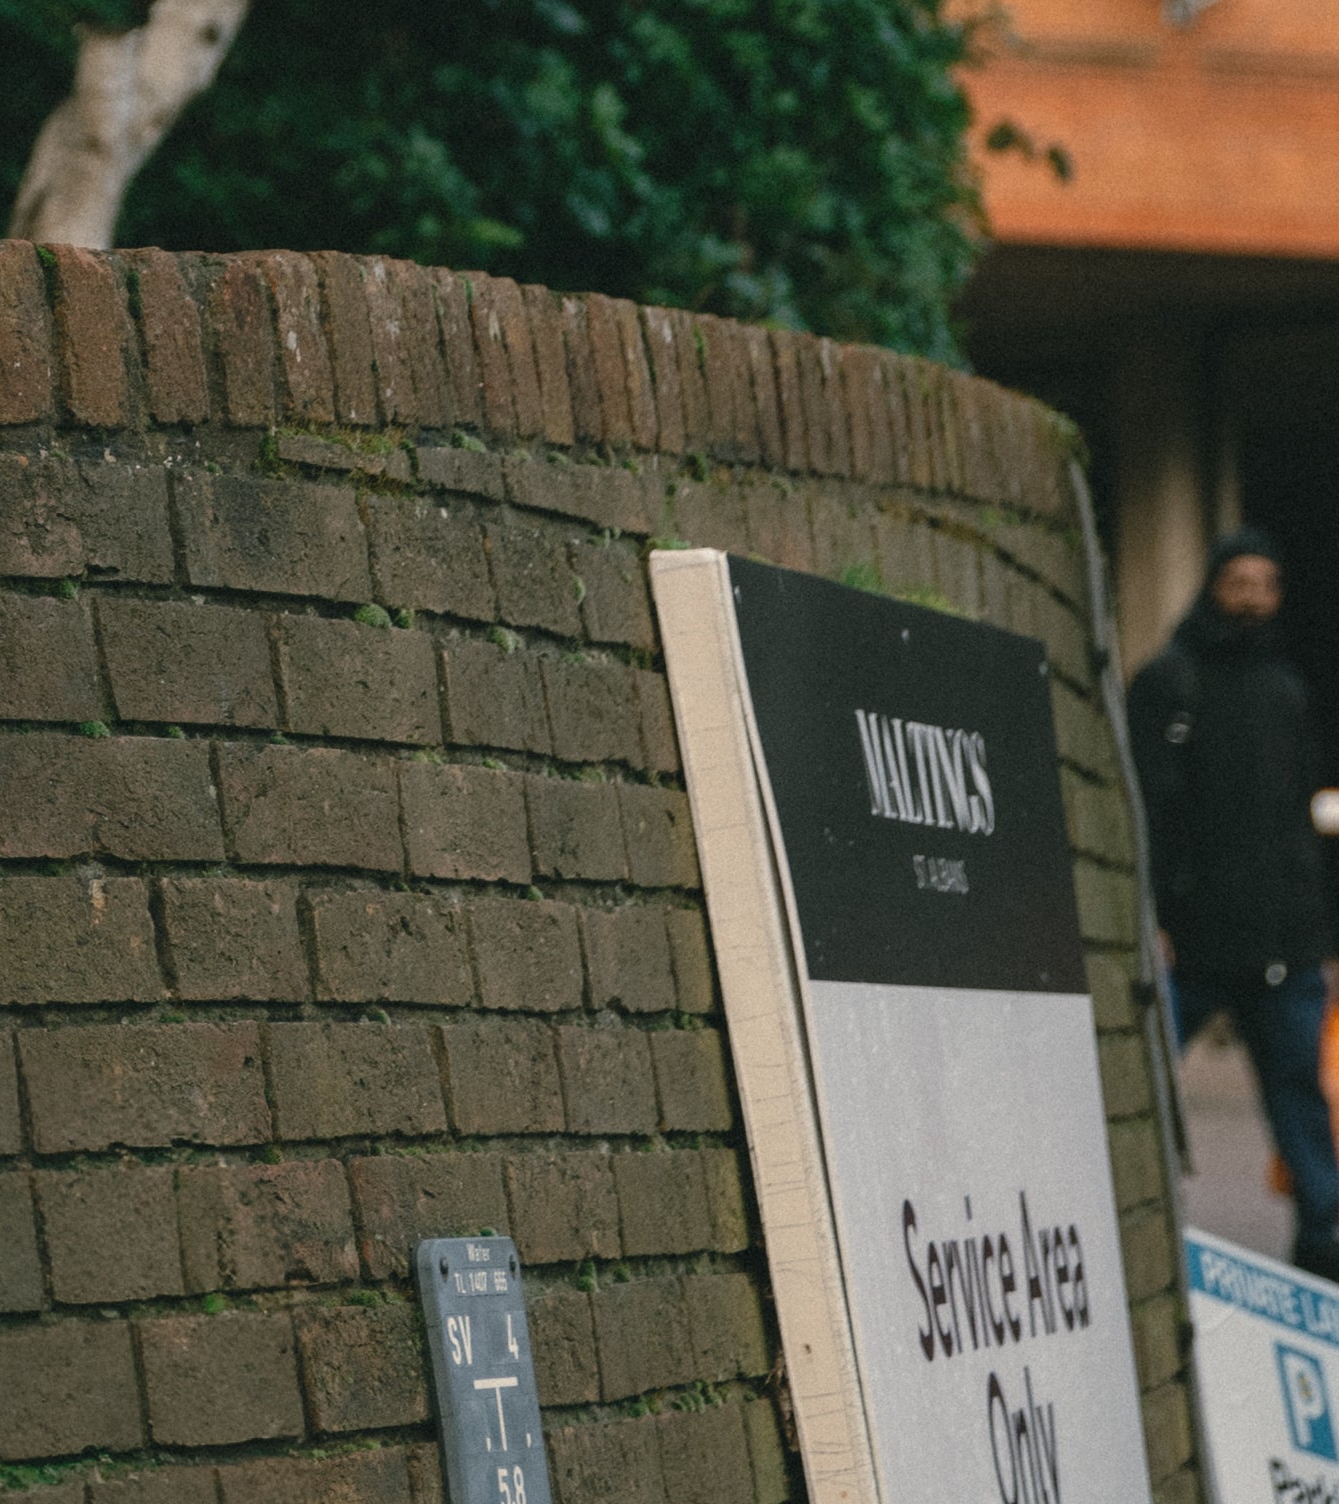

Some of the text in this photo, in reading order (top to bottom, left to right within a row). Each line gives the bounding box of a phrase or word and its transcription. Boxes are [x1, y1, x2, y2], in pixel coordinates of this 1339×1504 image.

[902, 1190, 1091, 1363] Service Area
[446, 1312, 520, 1366] SV 4
